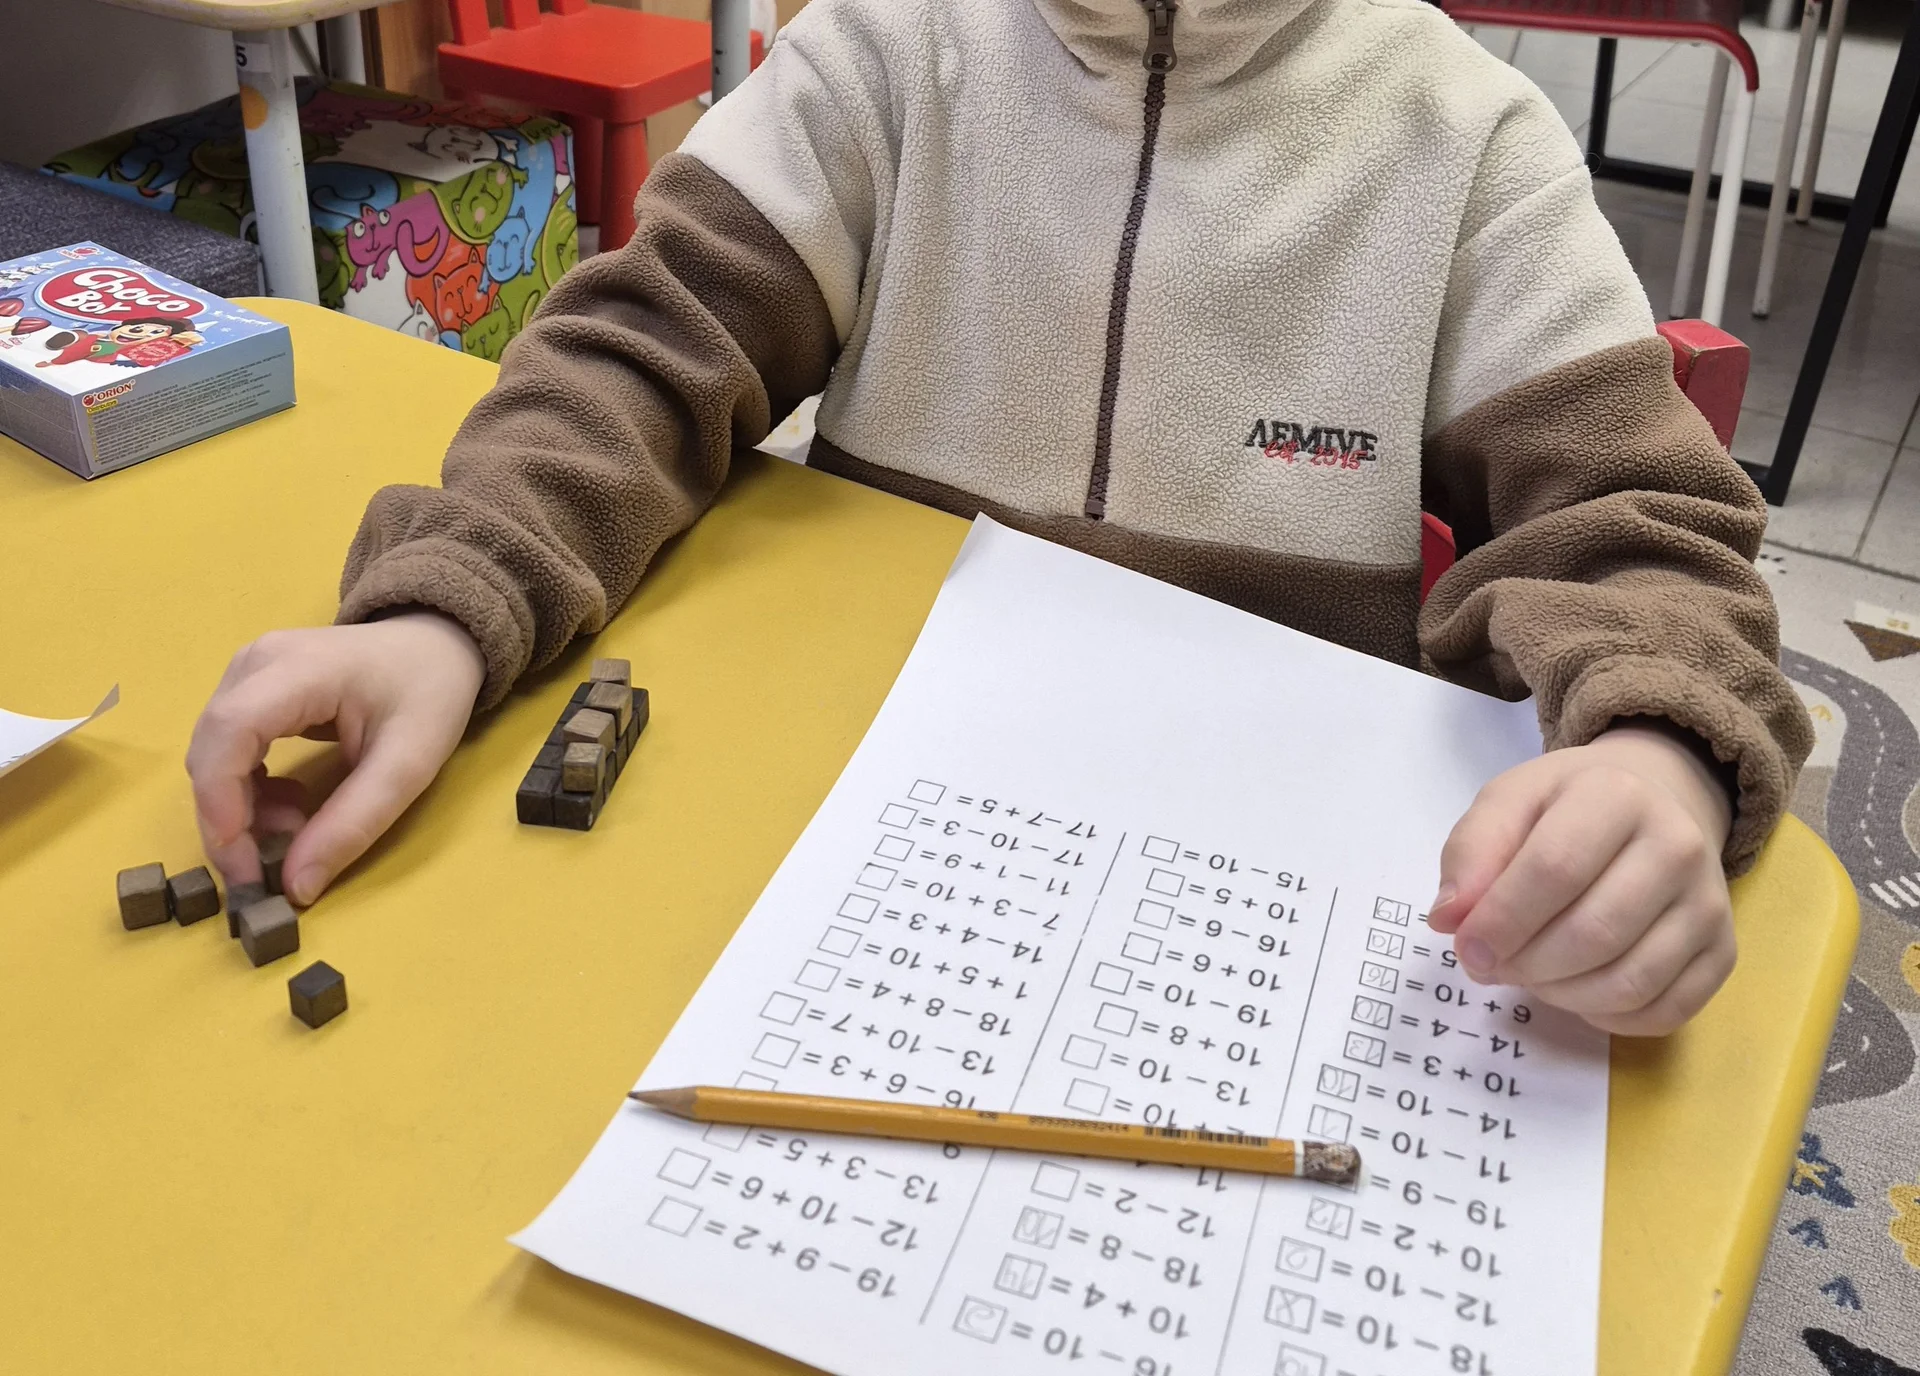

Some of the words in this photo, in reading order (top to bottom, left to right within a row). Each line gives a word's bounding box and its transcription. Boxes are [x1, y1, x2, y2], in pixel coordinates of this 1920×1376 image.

[73, 269, 191, 312] Choco
[96, 382, 133, 400] ORION
[979, 798, 999, 815] 5
[1025, 811, 1045, 827] 7
[942, 820, 962, 837] 3
[1065, 821, 1097, 839] 17
[990, 832, 1020, 852] 10
[943, 853, 963, 869] 9
[1052, 849, 1085, 867] 17
[1208, 853, 1239, 874] 10
[997, 864, 1007, 879] 1
[1275, 871, 1308, 893] 15
[925, 881, 956, 902] 10
[1045, 877, 1070, 897] 11
[1213, 887, 1233, 905] 5
[992, 898, 1012, 917] 3
[1267, 901, 1300, 924] 10
[908, 912, 928, 932] 3
[1041, 912, 1061, 931] 7
[1204, 919, 1223, 938] 6
[960, 926, 981, 945] 4
[1257, 934, 1291, 958] 16
[888, 946, 921, 970] 10
[1011, 940, 1043, 965] 14
[1191, 953, 1212, 973] 6
[1440, 949, 1458, 969] 5
[957, 965, 980, 986] 5
[1247, 968, 1282, 992] 10
[871, 980, 893, 1000] 4
[1014, 980, 1028, 1000] 1
[1163, 983, 1197, 1008] 10
[1433, 983, 1470, 1007] 10
[924, 997, 946, 1018] 8
[1236, 1003, 1273, 1029] 19
[1512, 1004, 1532, 1025] 6
[829, 1012, 853, 1034] 7
[978, 1011, 1012, 1037] 18
[1169, 1025, 1189, 1046] 8
[1430, 1018, 1451, 1038] 4
[887, 1029, 921, 1054] 10
[1226, 1041, 1262, 1067] 10
[1489, 1034, 1525, 1059] 14
[829, 1054, 852, 1077] 3
[960, 1049, 995, 1076] 13
[1138, 1058, 1173, 1084] 10
[1422, 1055, 1443, 1078] 3
[885, 1072, 908, 1094] 6
[1215, 1080, 1251, 1107] 13
[1483, 1071, 1522, 1098] 10
[1396, 1089, 1434, 1117] 10
[1479, 1111, 1517, 1141] 14
[783, 1139, 808, 1162] 5
[1391, 1131, 1429, 1160] 10
[843, 1156, 867, 1181] 3
[1478, 1155, 1512, 1184] 11
[739, 1176, 764, 1201] 6
[902, 1174, 938, 1205] 13
[1114, 1187, 1139, 1215] 2
[1402, 1180, 1423, 1206] 9
[800, 1195, 838, 1226] 10
[1176, 1207, 1215, 1239] 12
[1466, 1199, 1507, 1231] 19
[733, 1224, 761, 1250] 2
[879, 1219, 918, 1252] 12
[1099, 1234, 1123, 1261] 8
[1393, 1223, 1416, 1252] 2
[795, 1247, 821, 1272] 9
[1460, 1245, 1502, 1279] 10
[856, 1267, 896, 1299] 19
[1163, 1256, 1202, 1289] 18
[1364, 1265, 1406, 1298] 10
[1083, 1282, 1107, 1310] 4
[1455, 1291, 1498, 1327] 12
[1148, 1306, 1189, 1340] 10
[1356, 1315, 1399, 1351] 10
[1043, 1327, 1084, 1361] 10
[1452, 1344, 1494, 1376] 18
